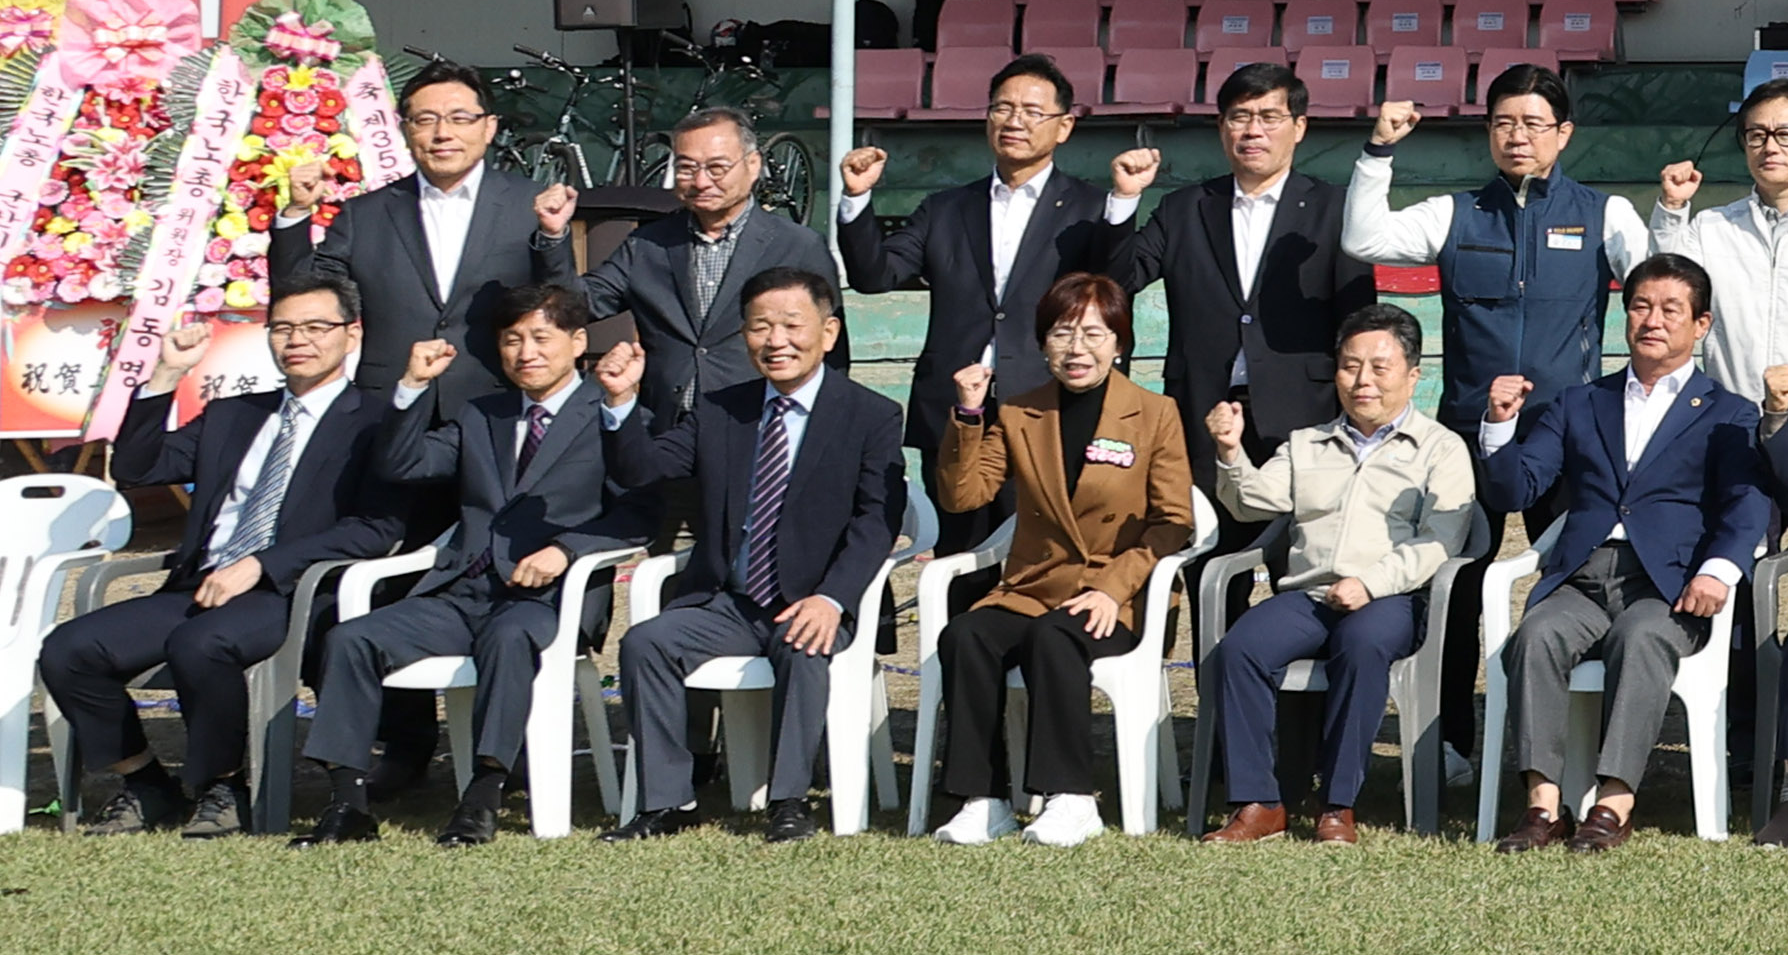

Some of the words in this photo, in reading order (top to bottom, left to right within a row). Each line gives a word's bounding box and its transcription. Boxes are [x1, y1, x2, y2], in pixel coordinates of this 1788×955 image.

[14, 85, 72, 168] 한국노총
[185, 78, 244, 198] 한국노총
[163, 206, 196, 267] 위원장
[21, 360, 99, 395] 祝賀
